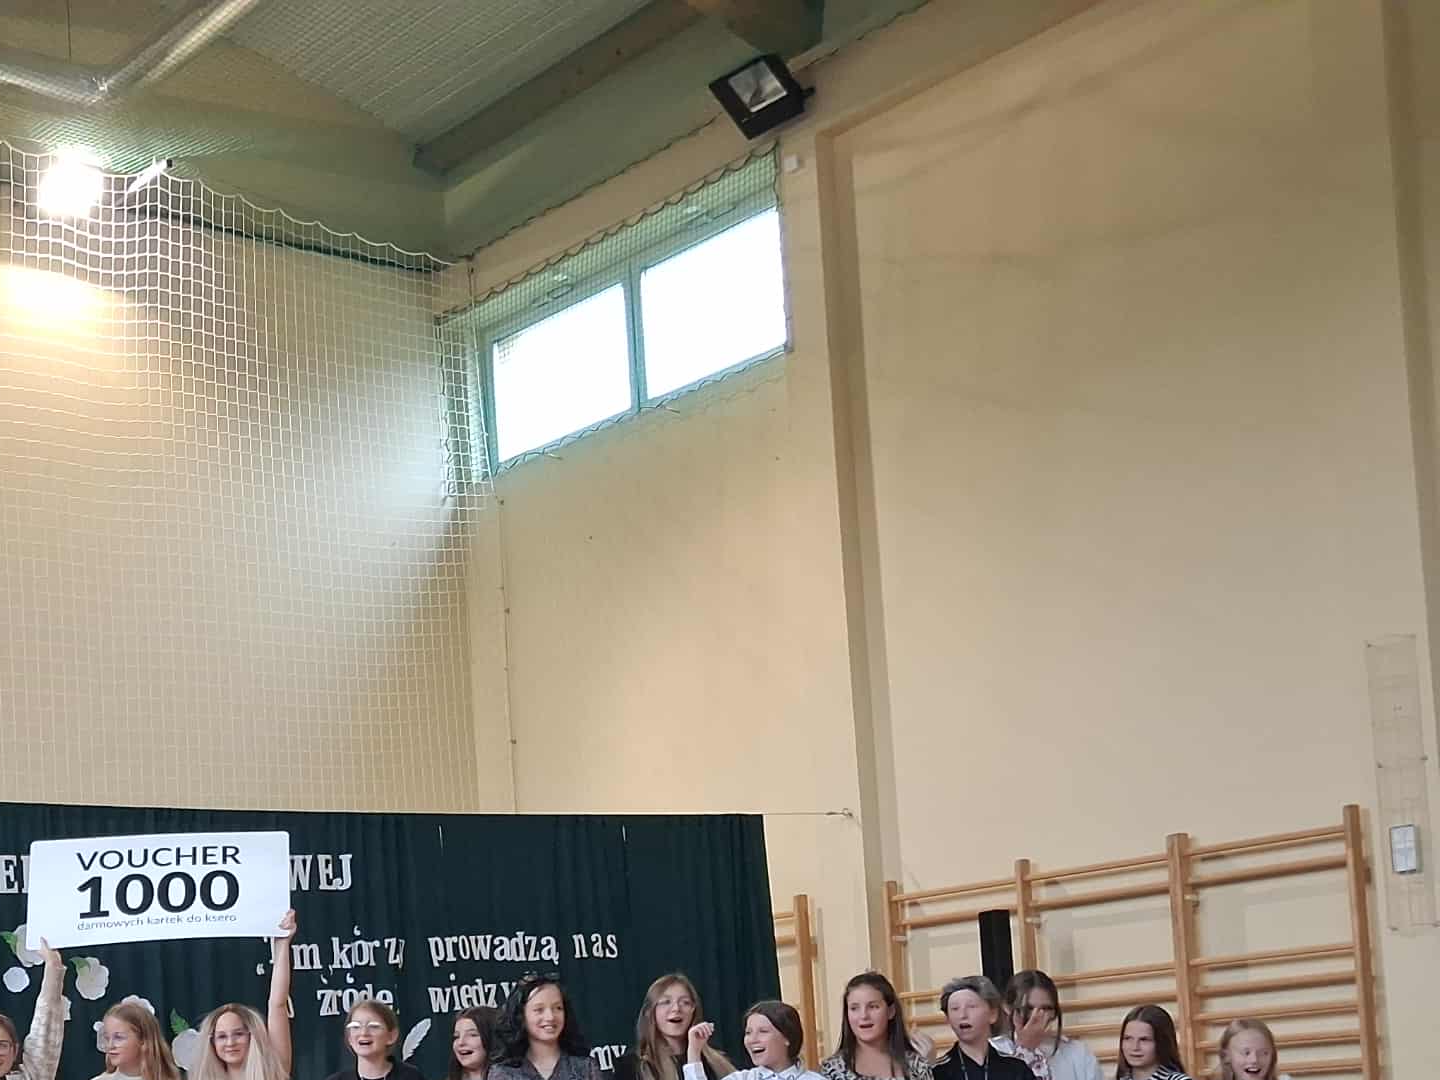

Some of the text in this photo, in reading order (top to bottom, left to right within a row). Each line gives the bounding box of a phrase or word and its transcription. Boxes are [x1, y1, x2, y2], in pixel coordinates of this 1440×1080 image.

[76, 845, 242, 871] VOUCHER
[77, 870, 240, 919] 1000
[77, 912, 237, 931] darmowych kartek do ksero
[428, 931, 559, 967] prowadzą
[572, 933, 618, 958] nas
